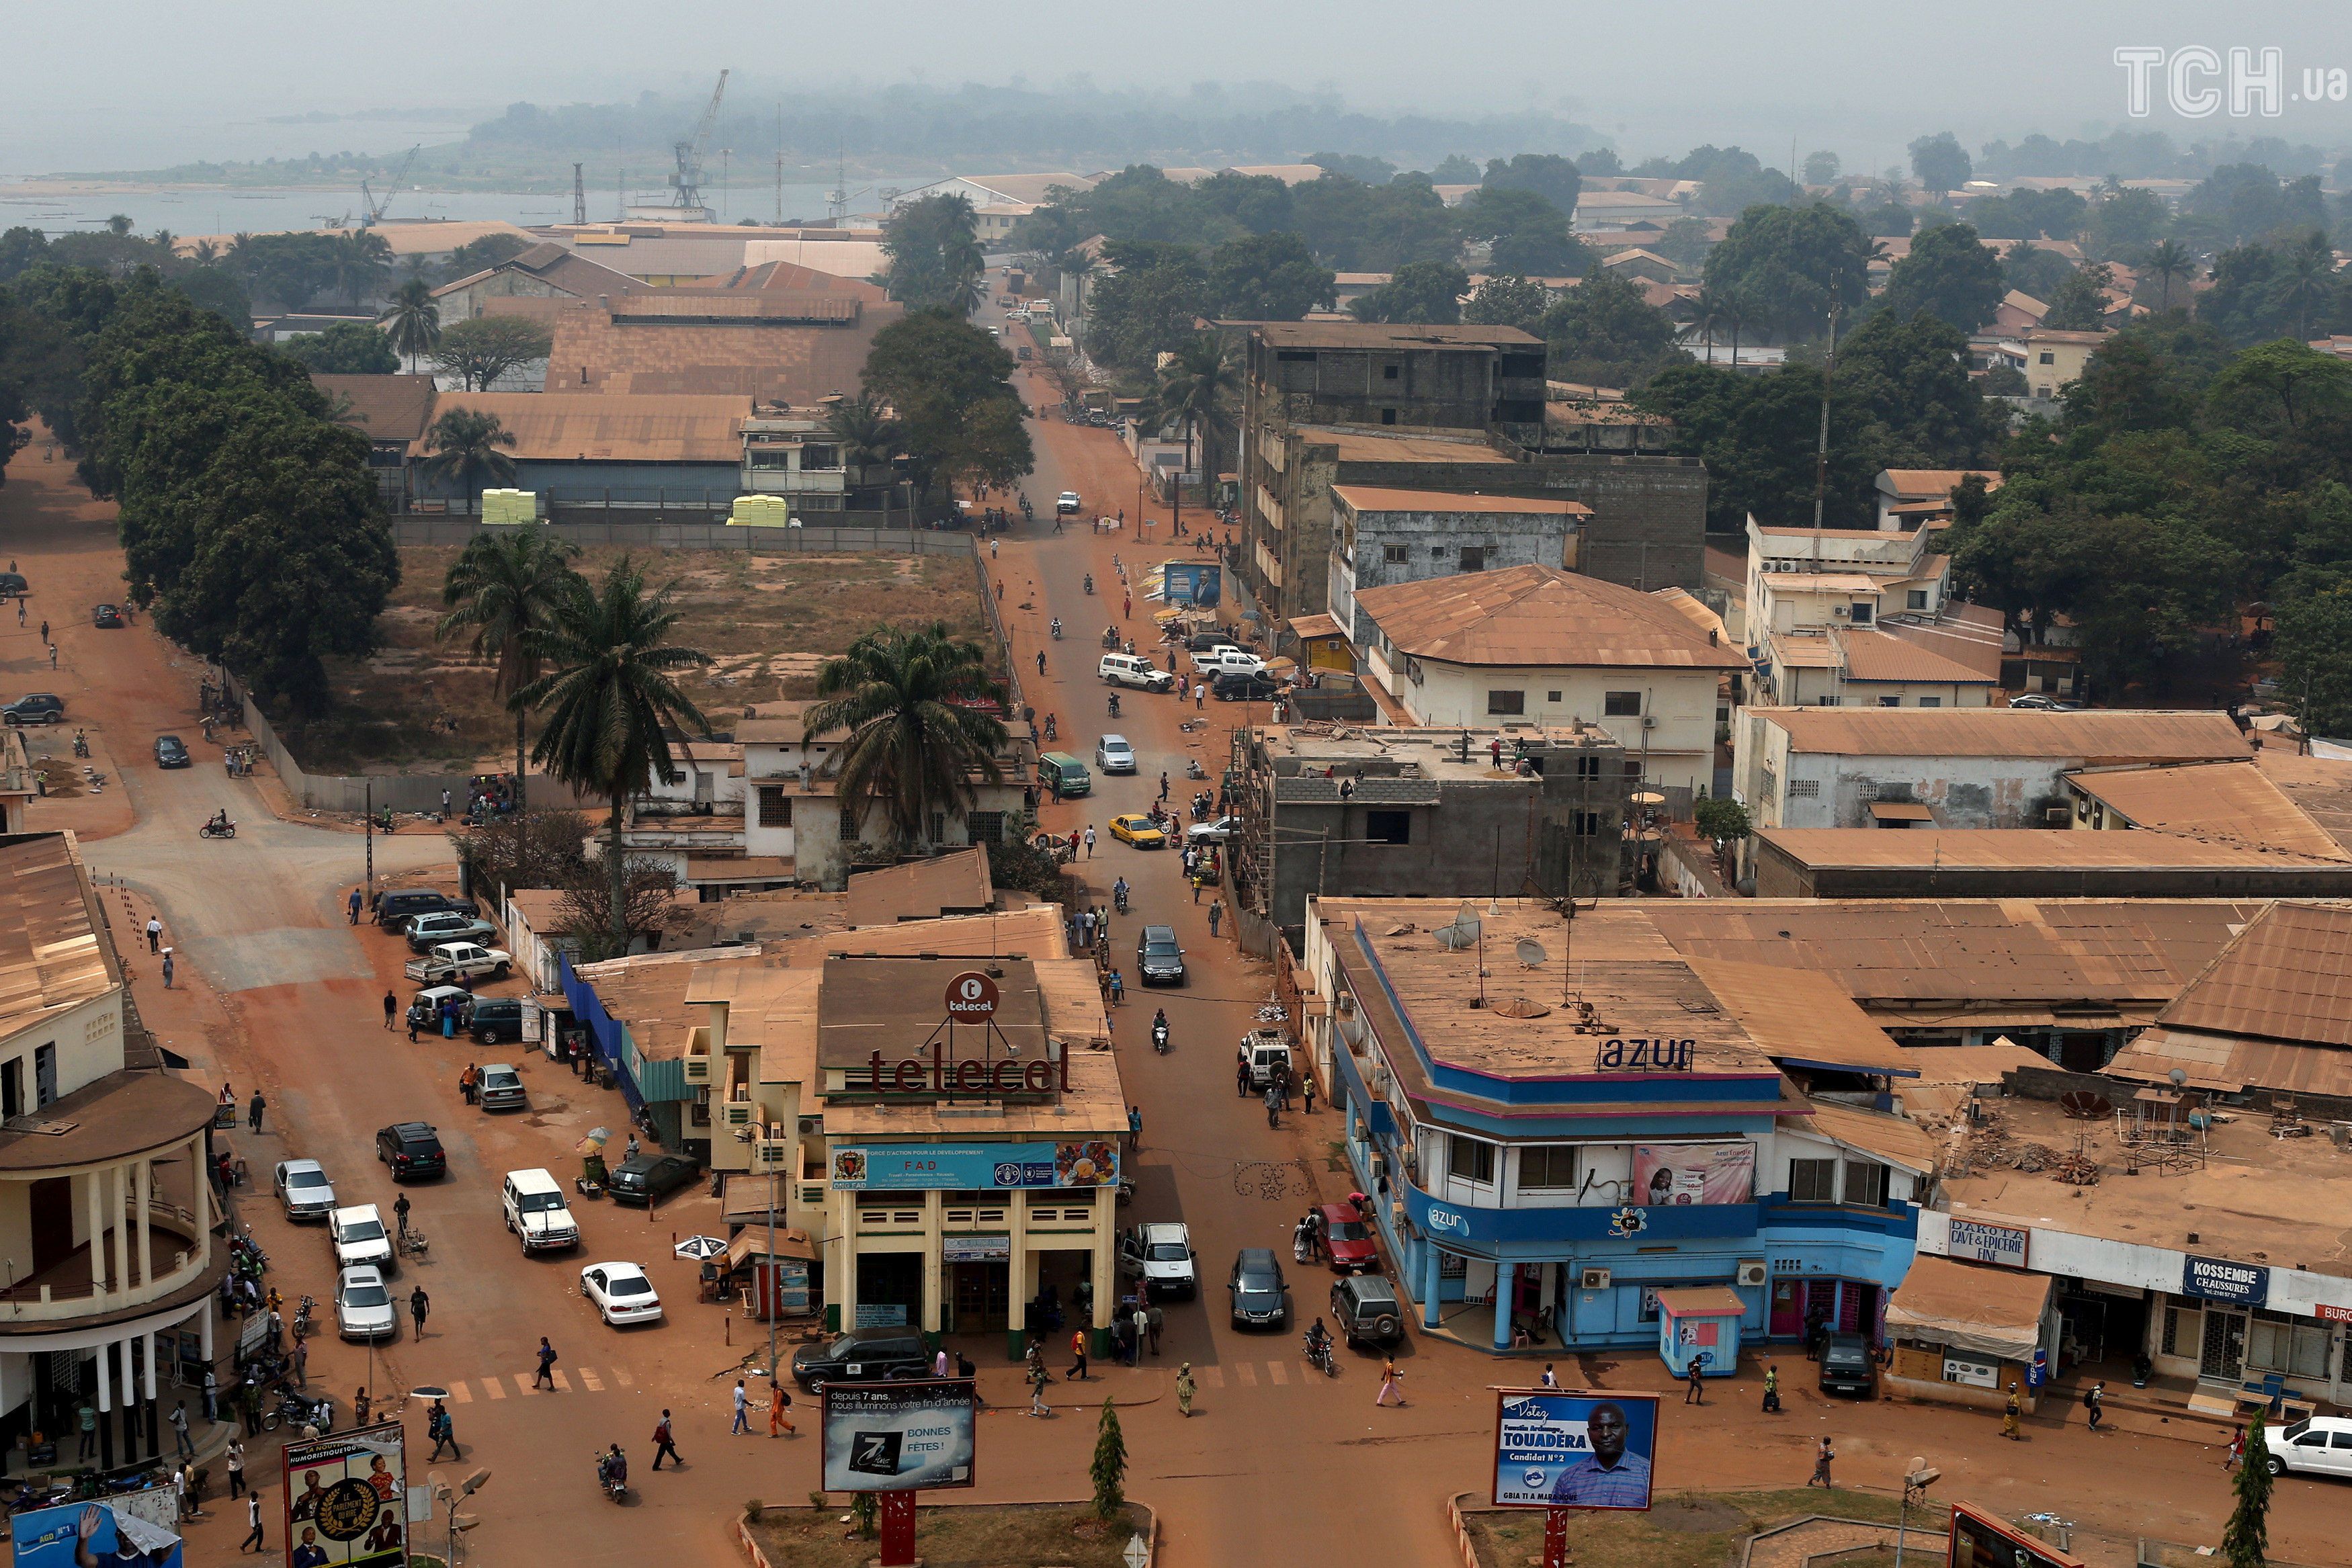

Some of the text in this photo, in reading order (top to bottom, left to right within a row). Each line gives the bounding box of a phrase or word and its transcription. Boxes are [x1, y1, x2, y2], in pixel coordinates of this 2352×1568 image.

[950, 1000, 993, 1011] telecel
[1602, 1039, 1695, 1068] azur
[868, 1041, 1073, 1094] telecel
[1432, 1209, 1461, 1227] azur
[1951, 1221, 2024, 1241] DAKOTA
[1951, 1230, 2023, 1254] CAVE & EPICERIE
[1978, 1248, 1998, 1262] FINE
[2193, 1262, 2257, 1284] KOSSEMBE
[2196, 1277, 2250, 1294] CHAUSSURES
[1701, 1353, 1712, 1361] zur
[831, 1392, 891, 1401] depuis 7 ans,
[831, 1397, 970, 1409] nous illuminons votre fin d'année
[1511, 1400, 1549, 1426] Votez
[908, 1427, 951, 1438] BONNES
[1504, 1430, 1587, 1448] TOUADÉRA
[908, 1442, 939, 1452] FÊTES
[290, 1448, 343, 1464] HUMORISTIQUE
[1509, 1453, 1565, 1463] Candidat N°2
[333, 1499, 362, 1512] PARLEMENT
[39, 1525, 70, 1543] AGD N°1
